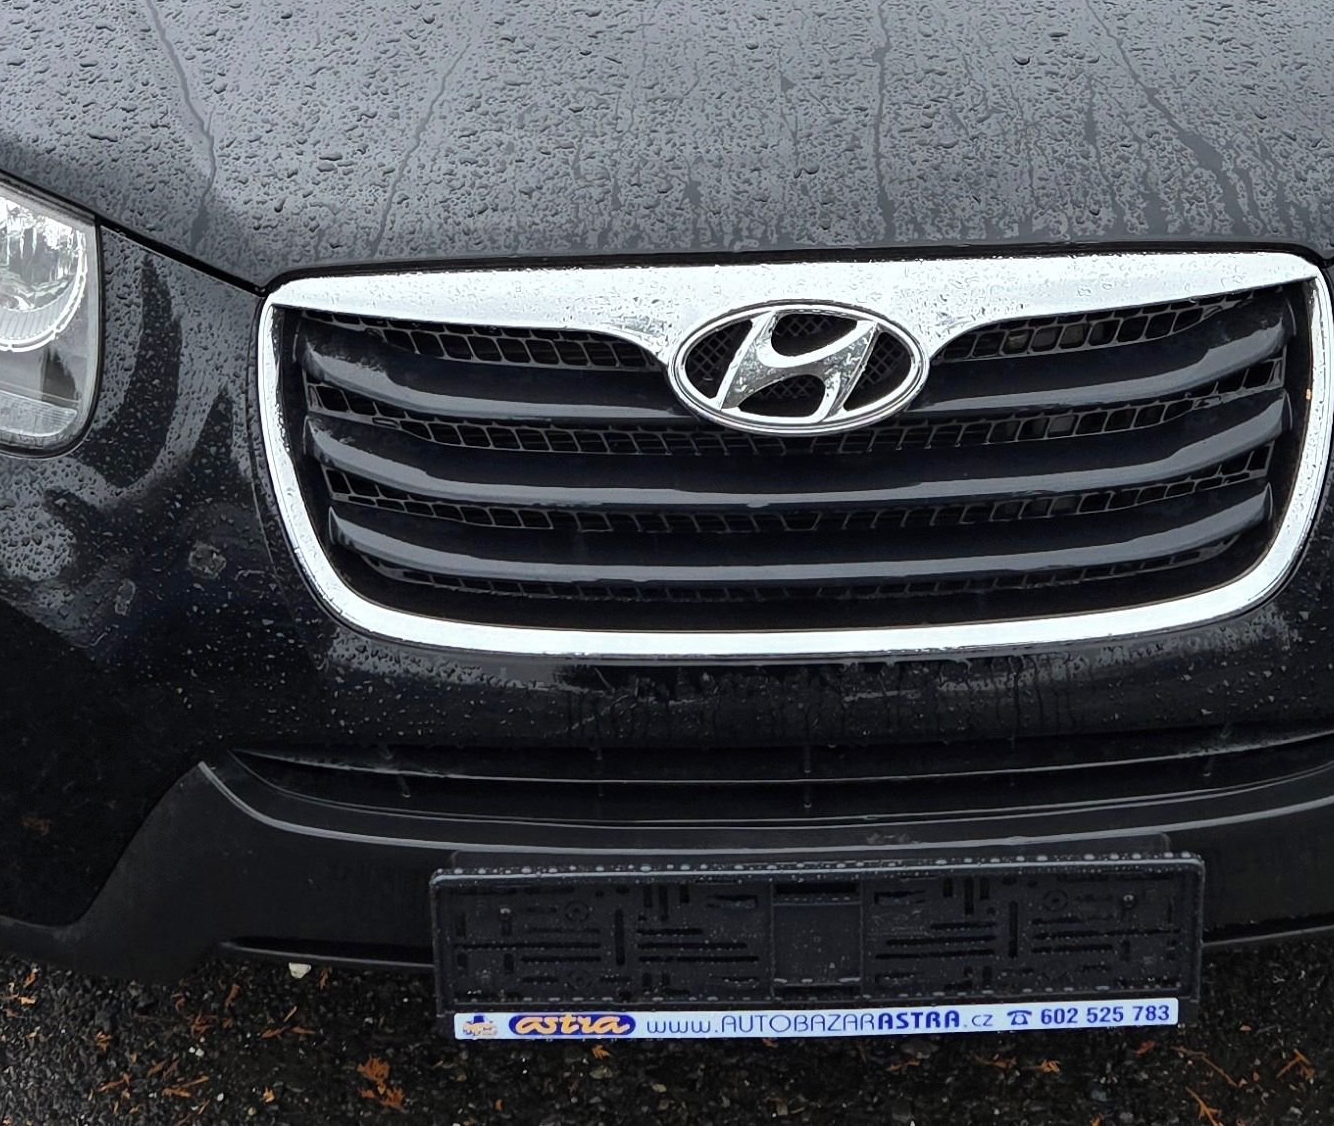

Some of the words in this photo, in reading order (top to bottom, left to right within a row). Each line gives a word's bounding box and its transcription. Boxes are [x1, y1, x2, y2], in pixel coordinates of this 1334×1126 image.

[515, 1013, 631, 1035] astra
[1040, 1007, 1079, 1025] 602
[1086, 1006, 1125, 1024] 525
[1132, 1004, 1170, 1022] 783
